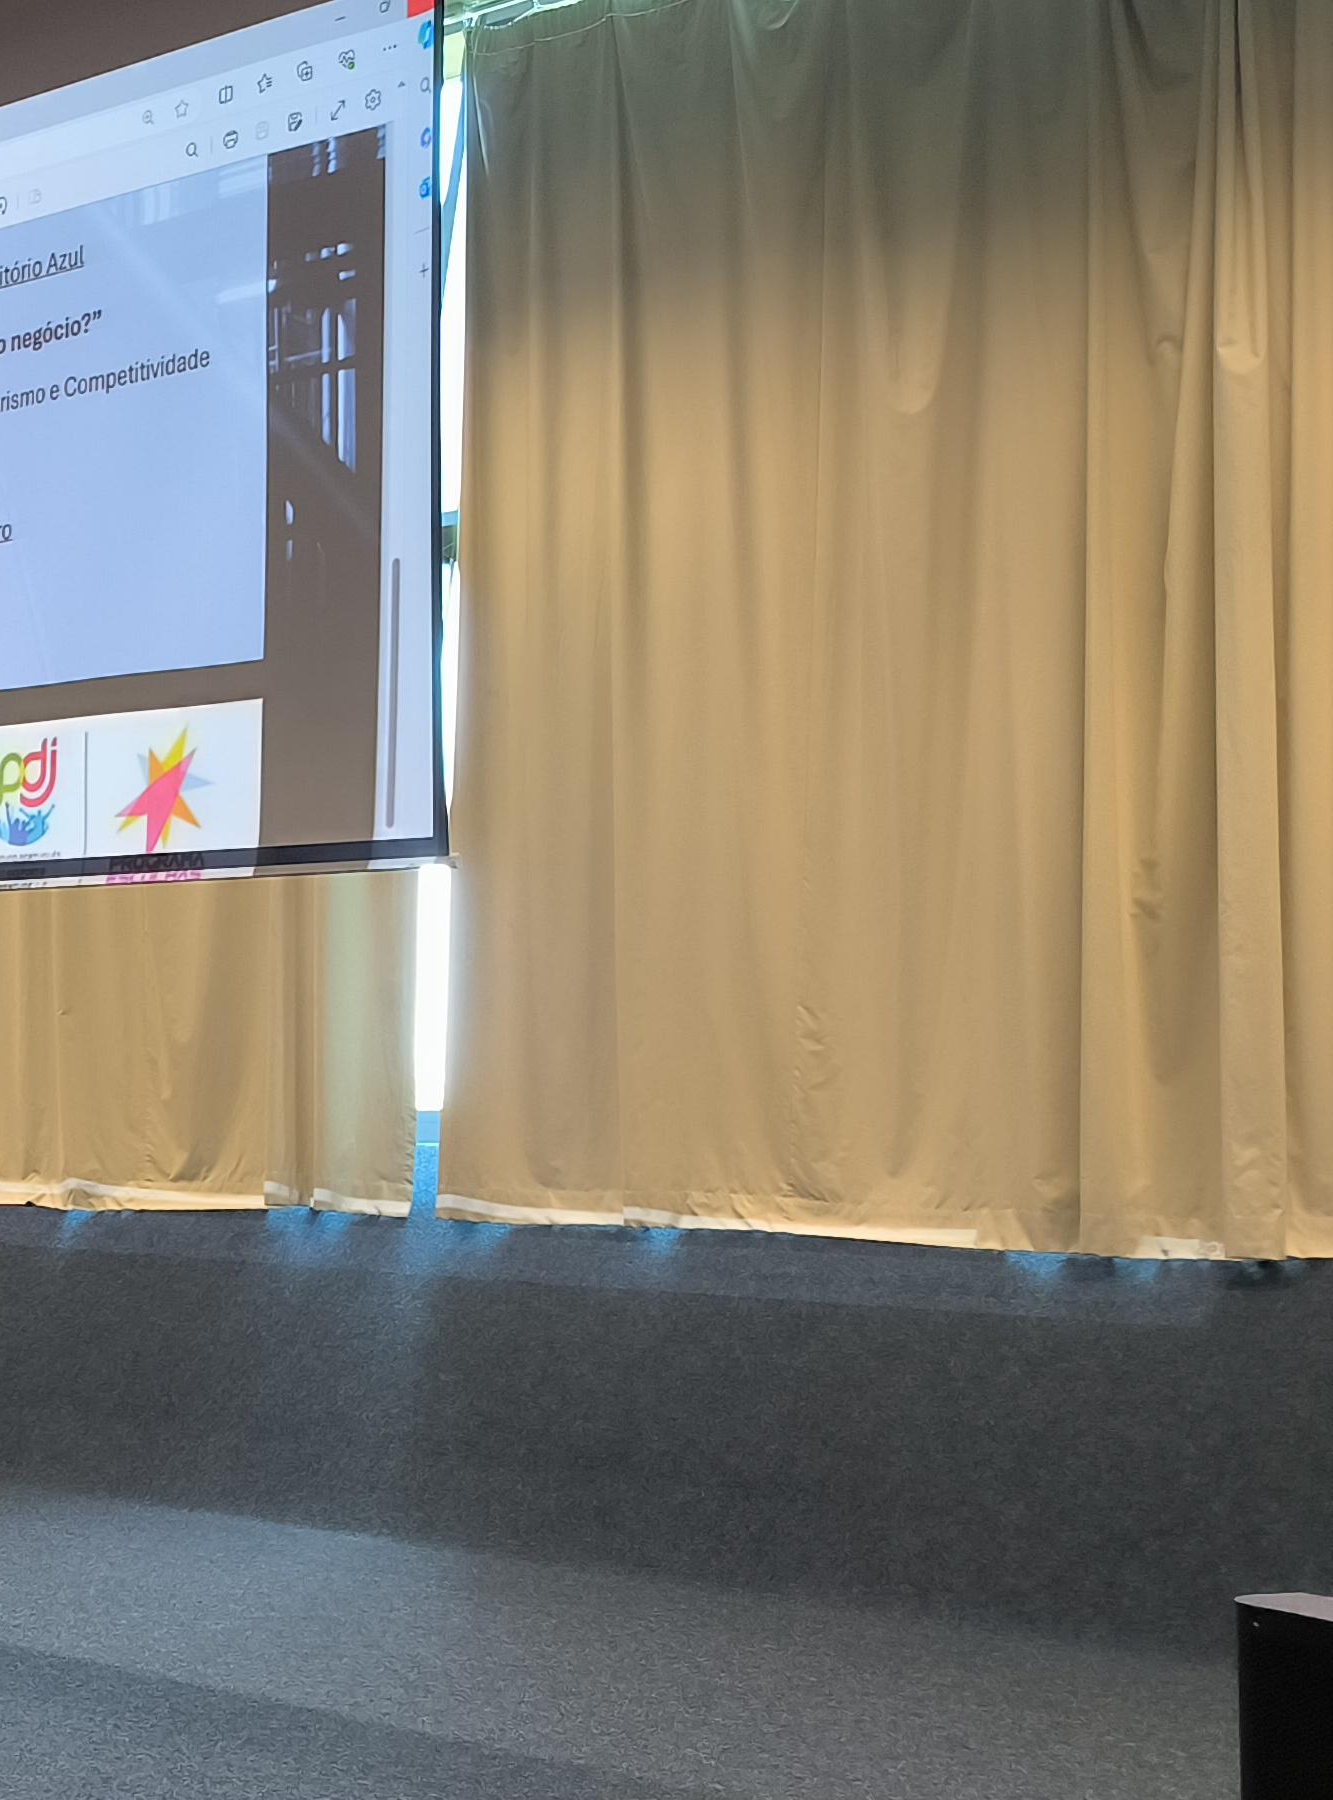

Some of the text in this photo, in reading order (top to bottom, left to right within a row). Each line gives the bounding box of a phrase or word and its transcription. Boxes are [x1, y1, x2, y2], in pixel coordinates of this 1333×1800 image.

[46, 244, 85, 275] Azul
[49, 384, 60, 401] e
[63, 348, 210, 397] Competitividade
